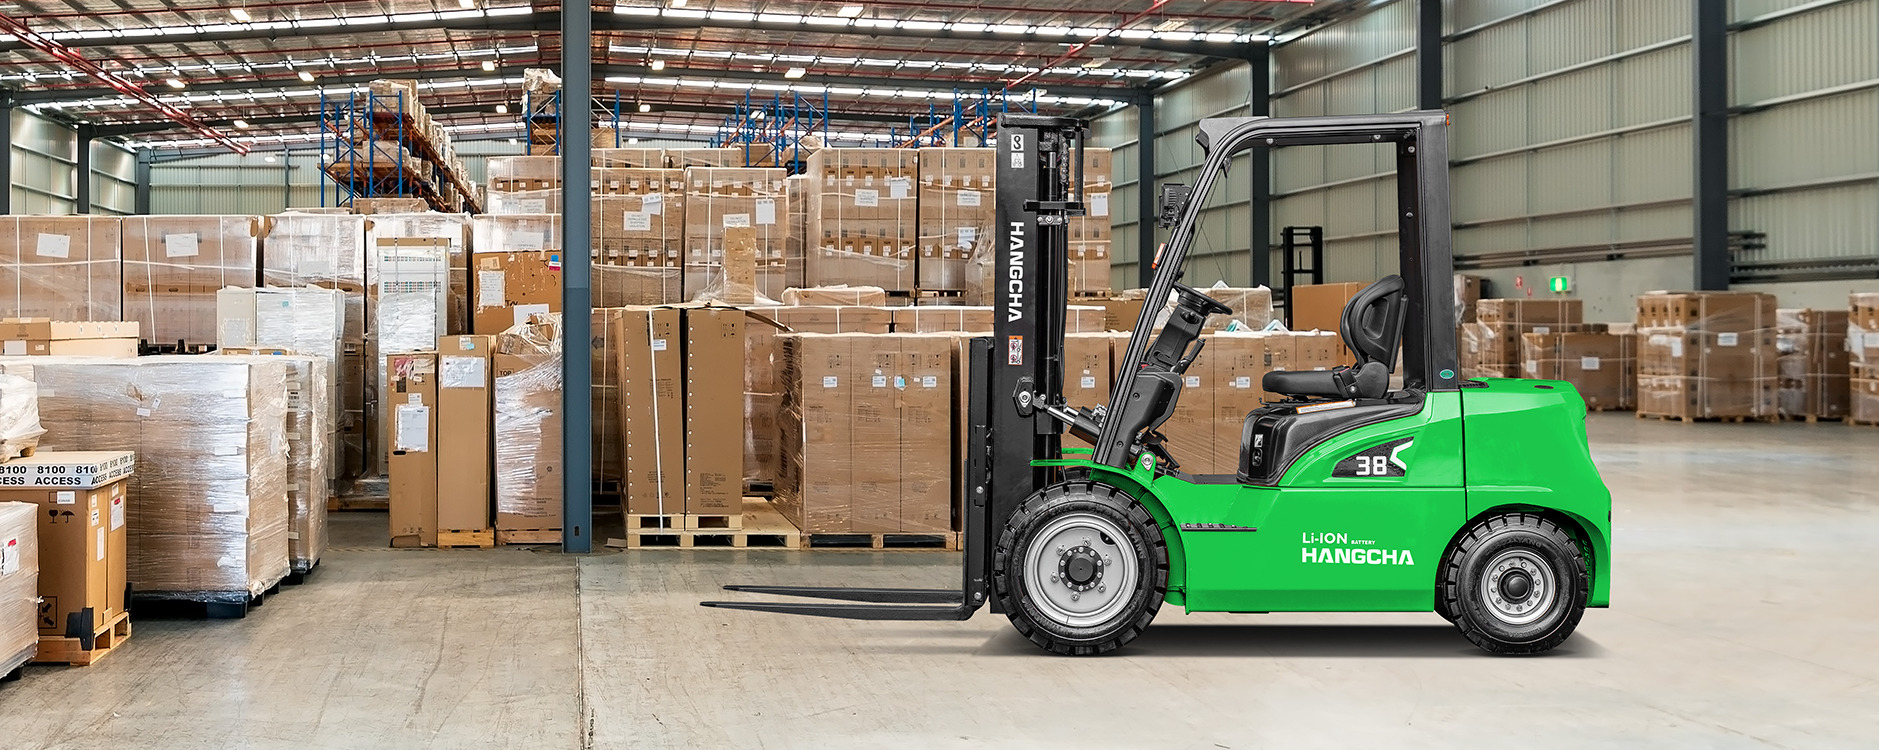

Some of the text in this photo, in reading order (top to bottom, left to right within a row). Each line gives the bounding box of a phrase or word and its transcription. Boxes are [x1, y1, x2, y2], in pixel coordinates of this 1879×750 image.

[1008, 221, 1024, 322] HANGCHA
[37, 465, 65, 474] 8100
[1356, 456, 1387, 475] 38
[35, 476, 81, 485] ACCESS
[91, 472, 107, 485] ACCESS
[109, 468, 121, 479] ACCESS
[1303, 532, 1347, 544] Li-ION
[1302, 547, 1414, 565] HANGCHA
